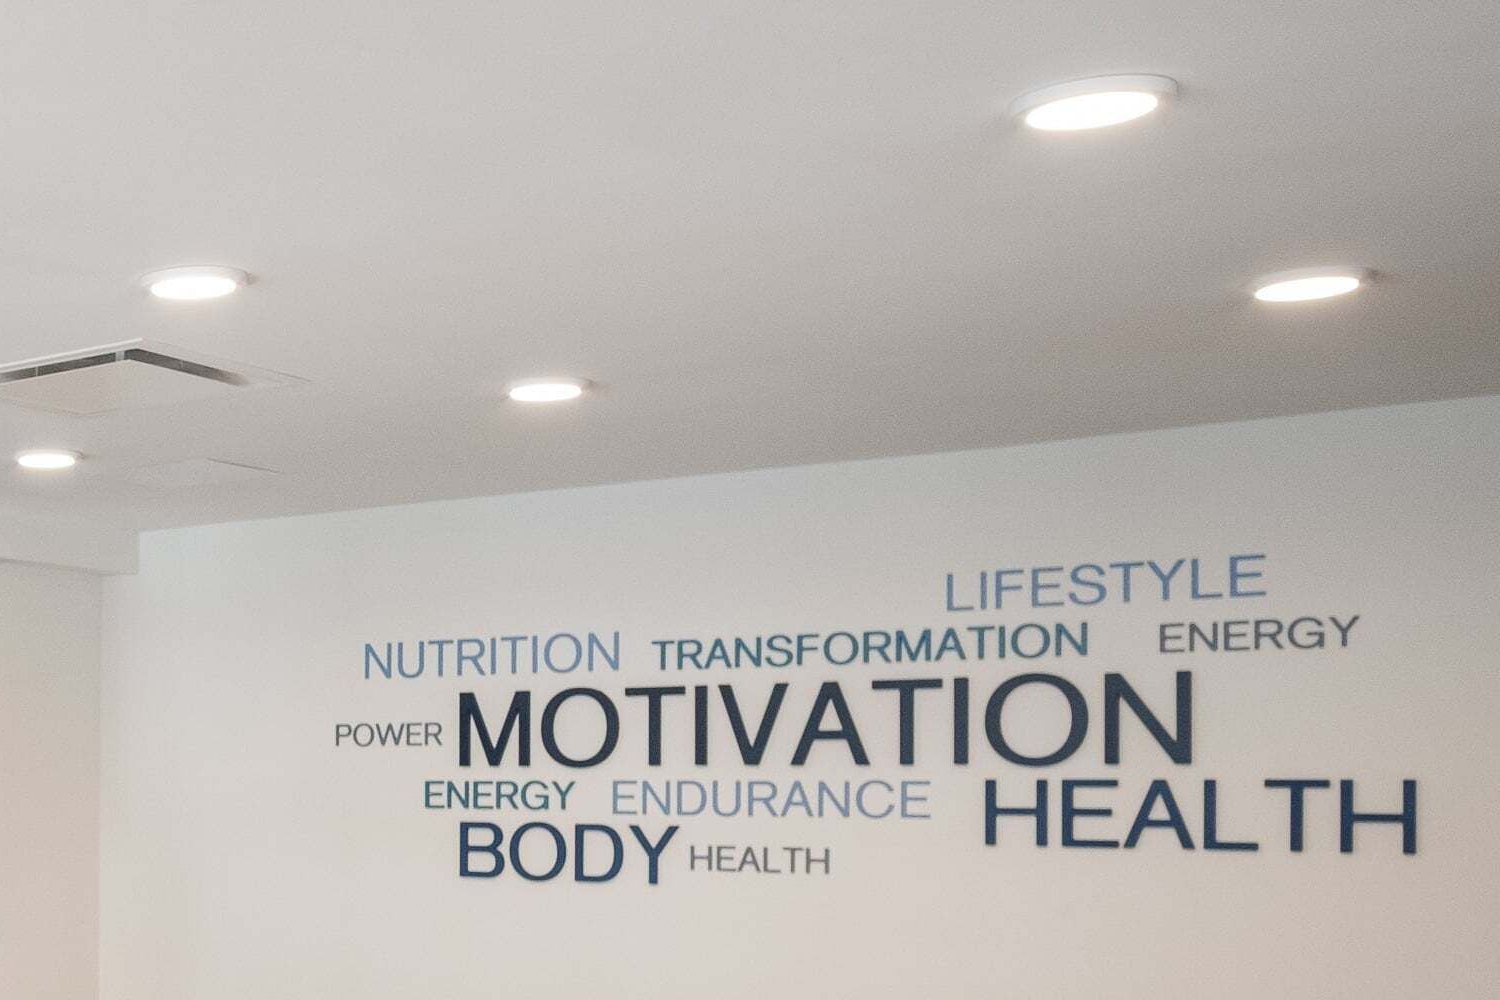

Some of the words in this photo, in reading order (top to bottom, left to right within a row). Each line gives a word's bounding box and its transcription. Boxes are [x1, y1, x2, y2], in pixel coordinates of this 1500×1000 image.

[945, 553, 1267, 612] LIFESTYLE
[363, 631, 621, 680] NUTRITION
[651, 621, 1089, 671] TRANSFORMATION
[1158, 615, 1360, 655] ENERGY
[335, 721, 443, 748] POWER
[457, 670, 1193, 768] MOTIVATION
[423, 780, 576, 810] ENERGY
[612, 780, 932, 820] ENDURANCE
[984, 779, 1417, 855] HEALTH
[458, 821, 681, 885] BODY
[690, 845, 832, 875] HEALTH
